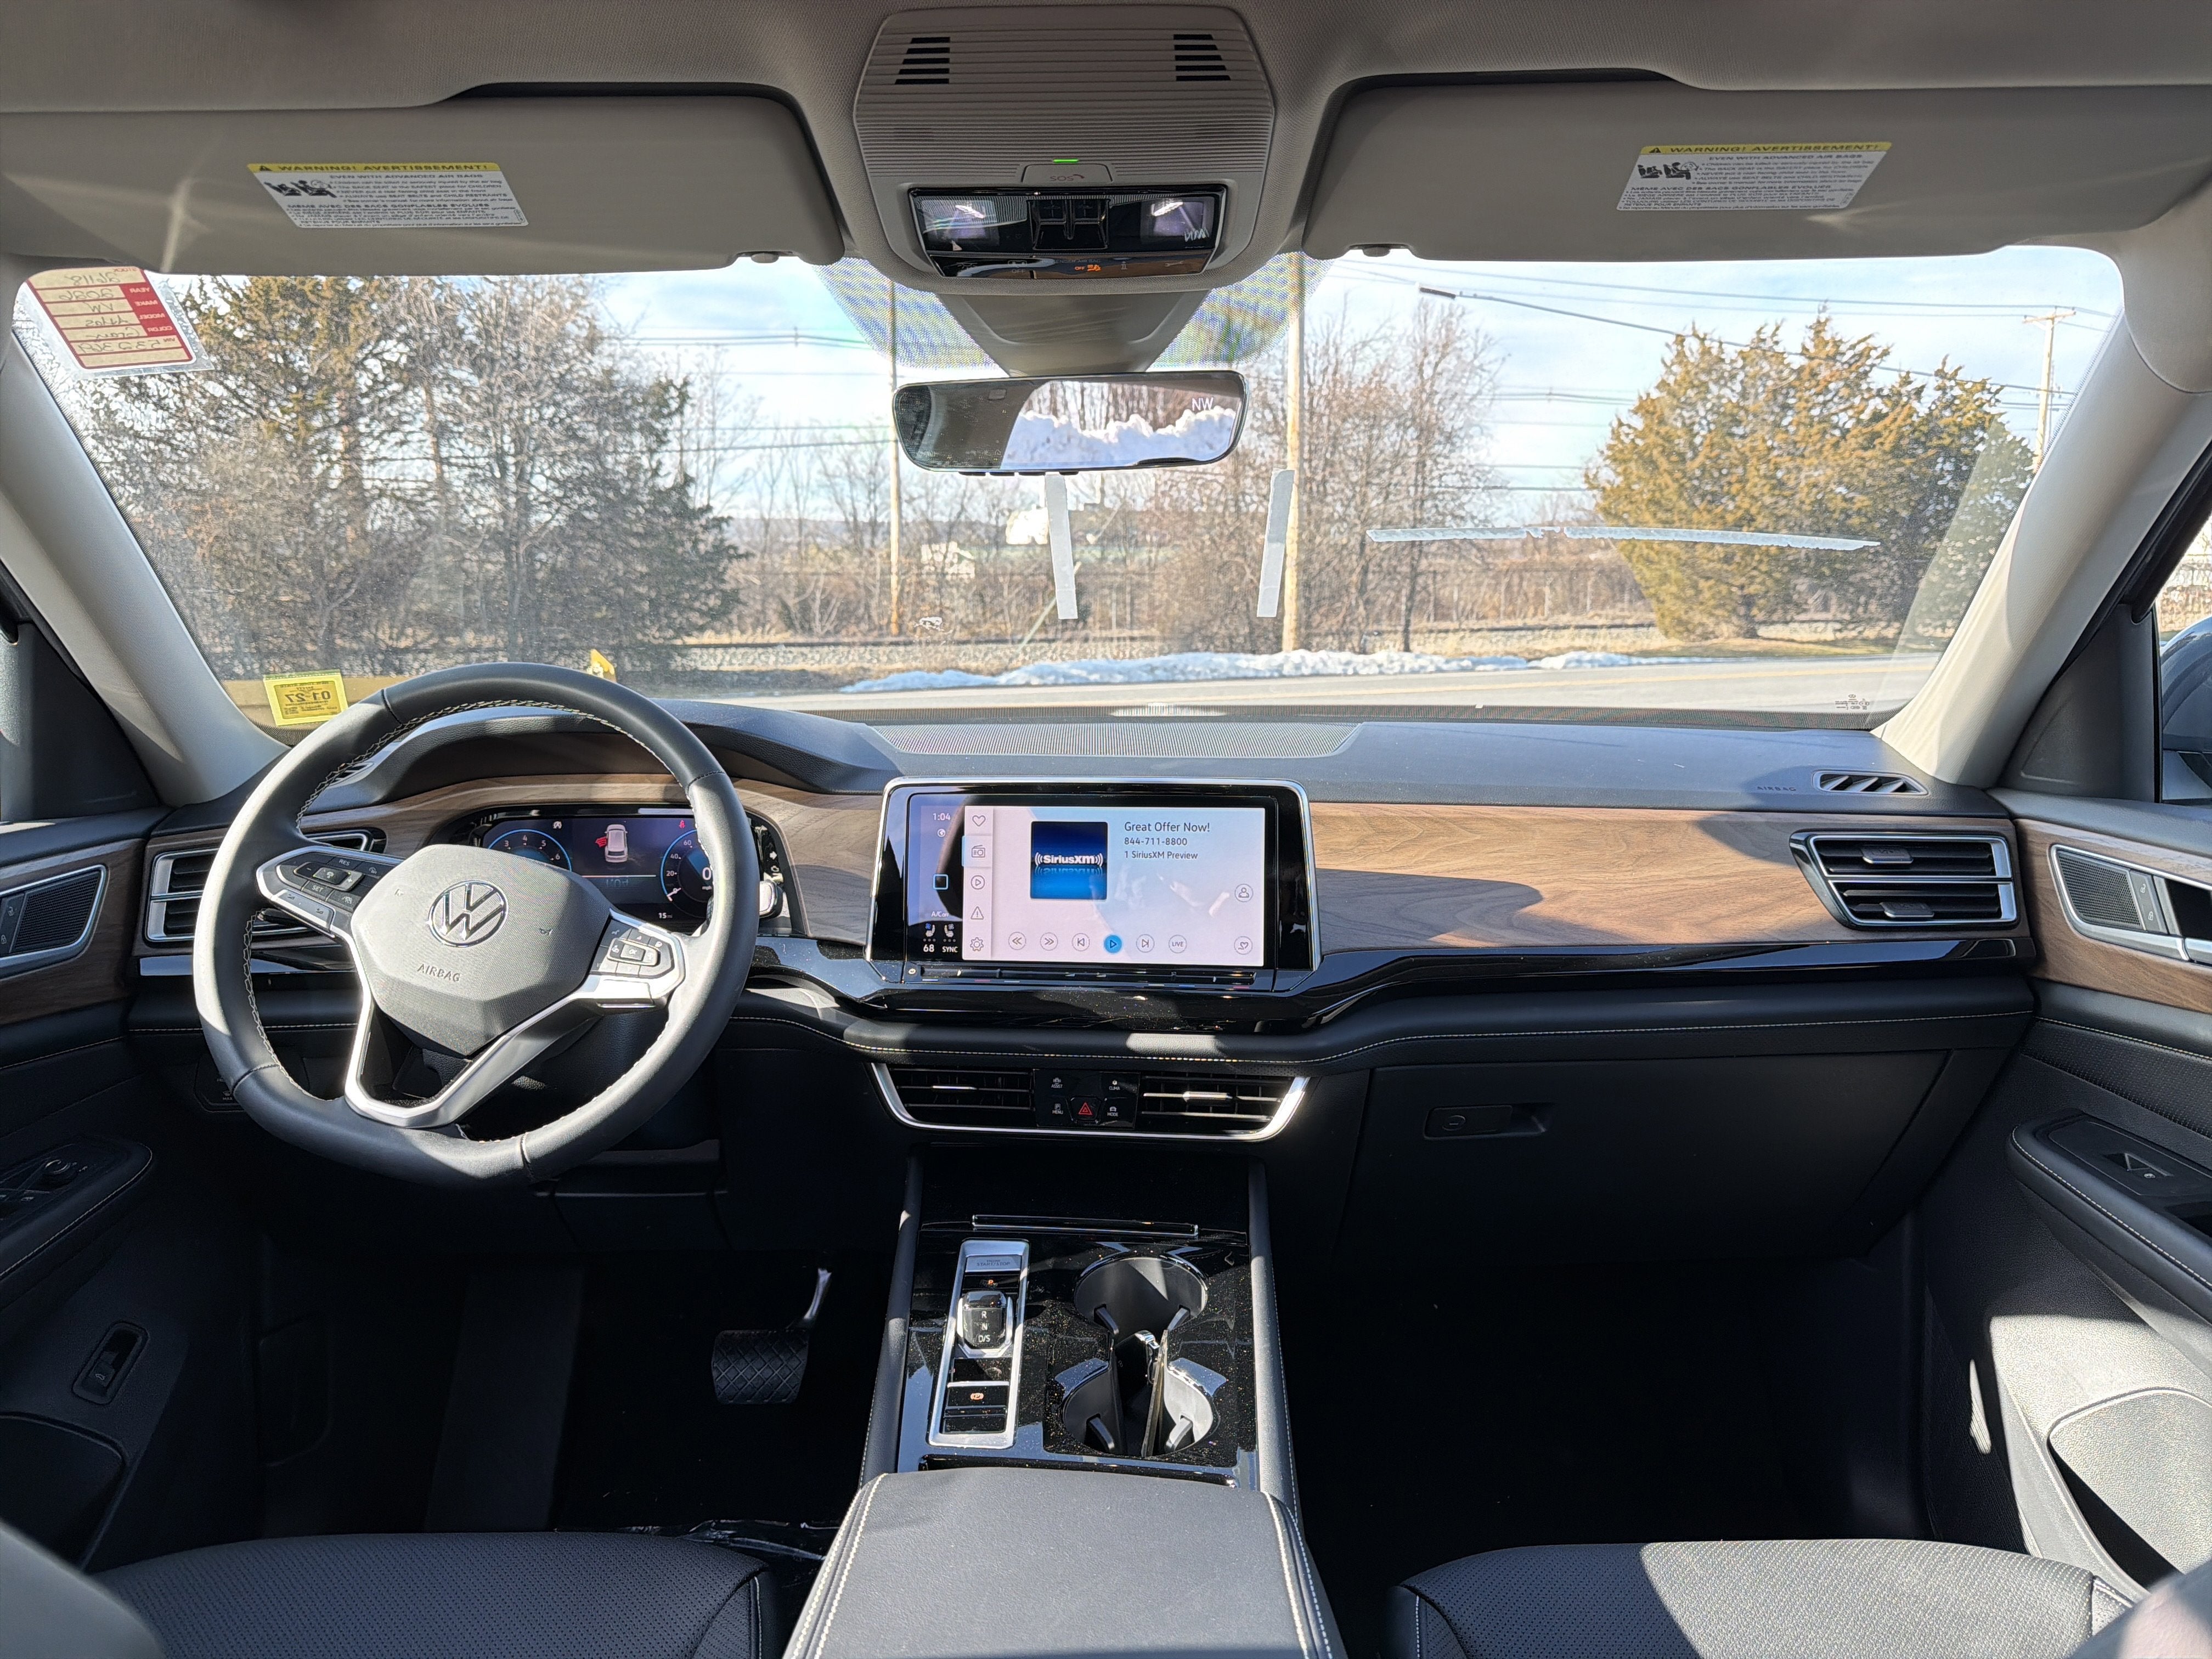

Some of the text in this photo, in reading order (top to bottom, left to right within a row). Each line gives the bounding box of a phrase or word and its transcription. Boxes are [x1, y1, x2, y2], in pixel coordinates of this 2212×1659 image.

[1192, 397, 1214, 411] NW
[1125, 822, 1210, 832] Great Offer Now!
[1125, 837, 1187, 845] 844-711-8800
[1132, 850, 1164, 859] SiriusXM
[1167, 851, 1198, 859] Preview
[702, 867, 712, 880] 0
[417, 964, 460, 982] AIRBAG
[981, 1311, 987, 1319] R
